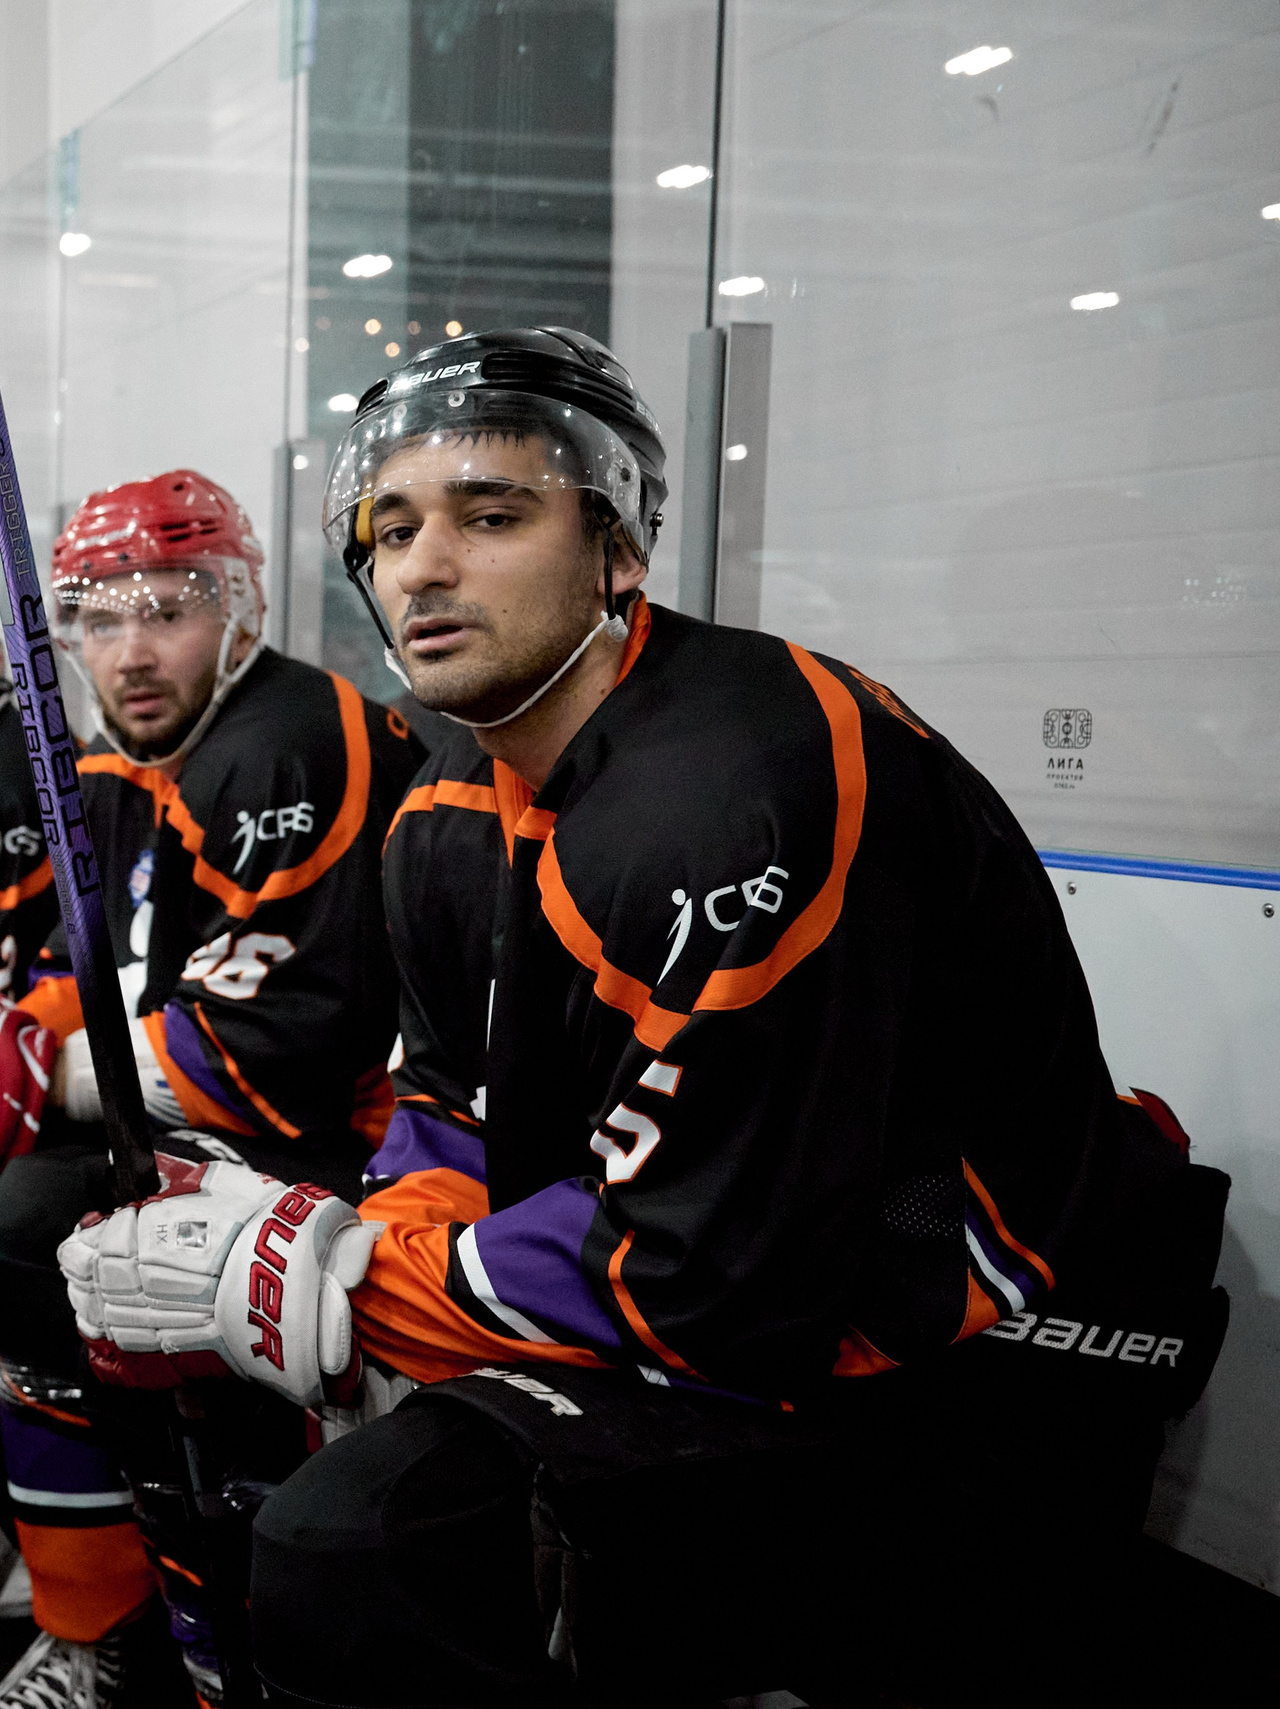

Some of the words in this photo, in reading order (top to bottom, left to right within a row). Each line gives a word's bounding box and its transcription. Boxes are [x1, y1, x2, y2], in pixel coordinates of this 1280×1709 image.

[10, 661, 61, 846] RIBCOR
[19, 593, 101, 897] RIBCOR
[1047, 757, 1084, 770] ЛИГА
[155, 1223, 168, 1244] HX
[247, 1182, 335, 1372] BAUER
[981, 1311, 1184, 1367] BAUER
